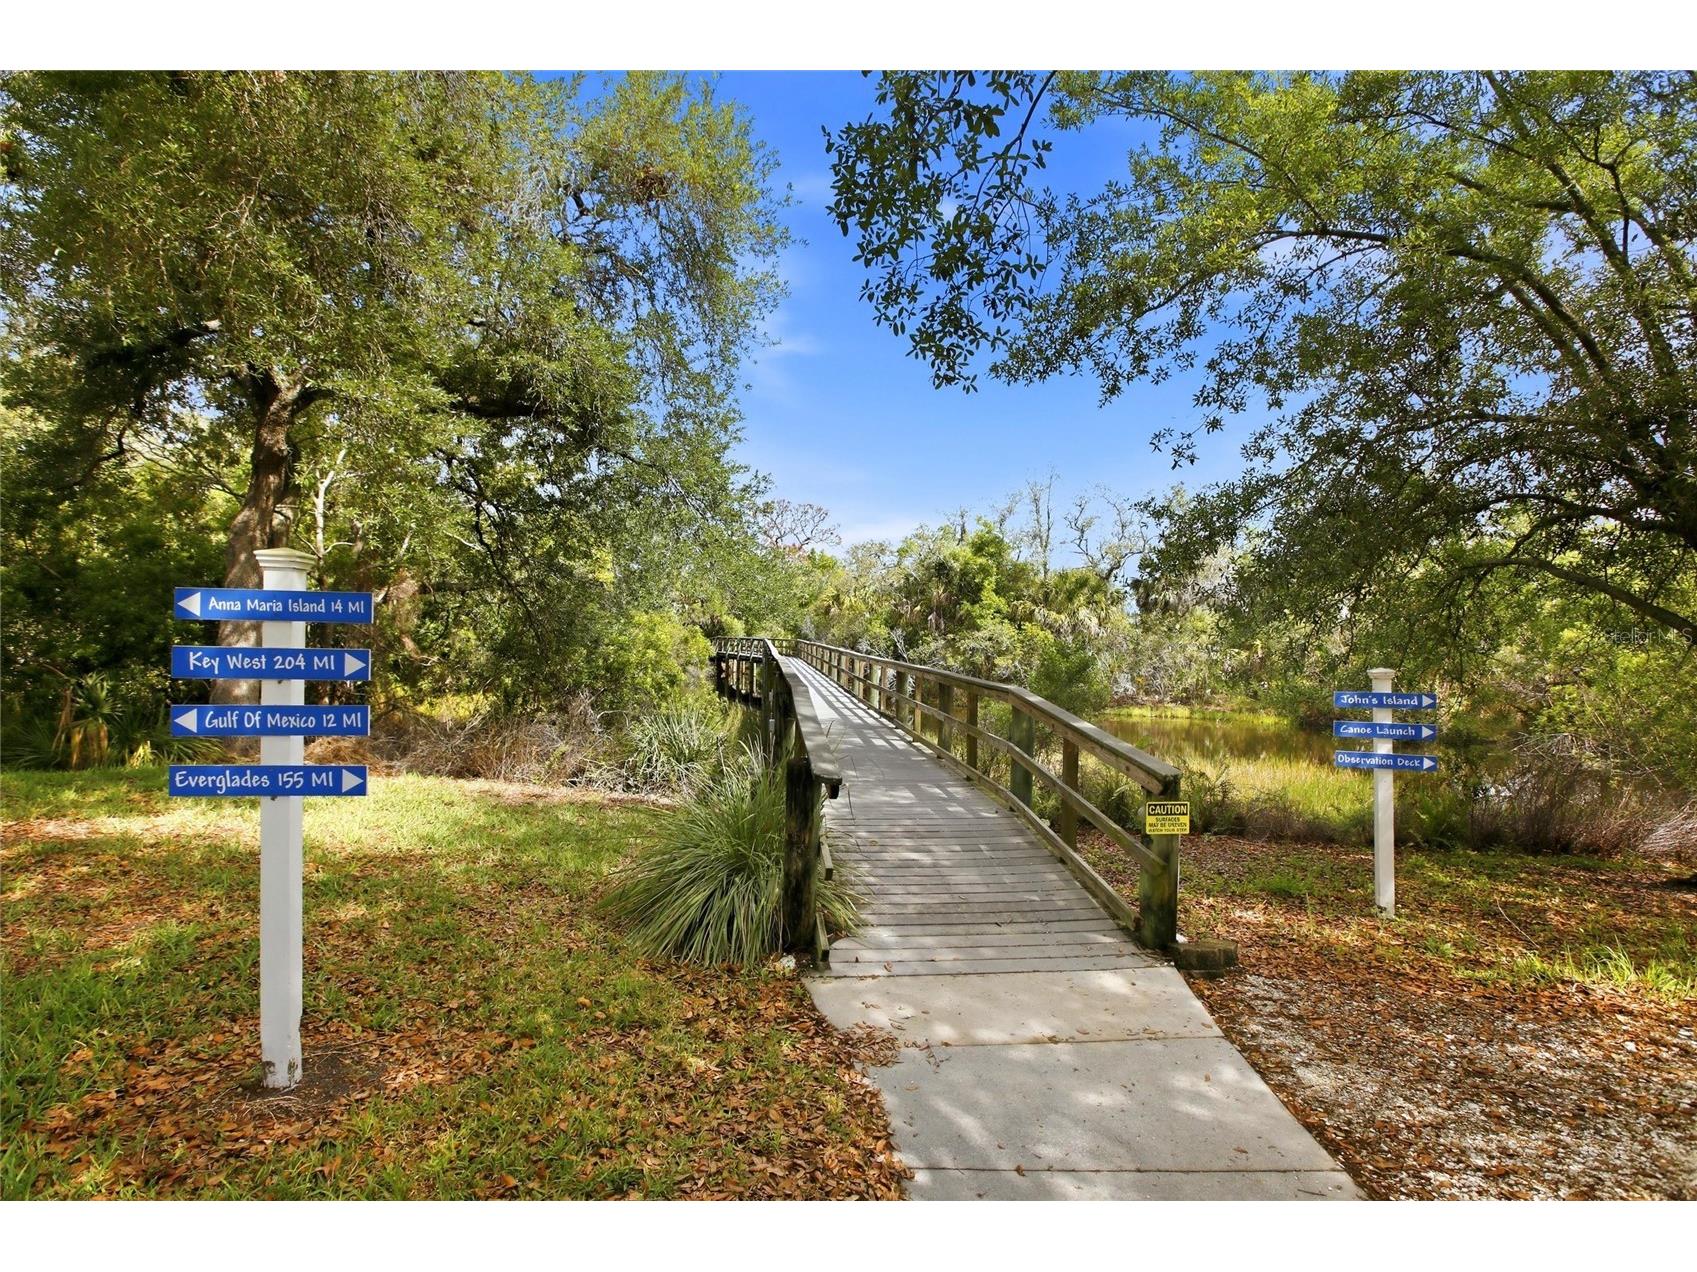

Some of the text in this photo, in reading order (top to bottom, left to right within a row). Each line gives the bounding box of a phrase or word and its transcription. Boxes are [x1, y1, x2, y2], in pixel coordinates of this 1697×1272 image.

[208, 596, 364, 614] Anna Maria Island 14 MI
[188, 651, 335, 674] Key West 204 MI
[1340, 694, 1418, 706] John's Island
[204, 710, 361, 729] Gulf Of Mexico 12 MI
[1340, 724, 1416, 736] Canoe Launch
[1337, 754, 1421, 767] Observation Deck
[174, 769, 333, 795] Everglades 155 MI
[1149, 805, 1187, 815] CAUTION
